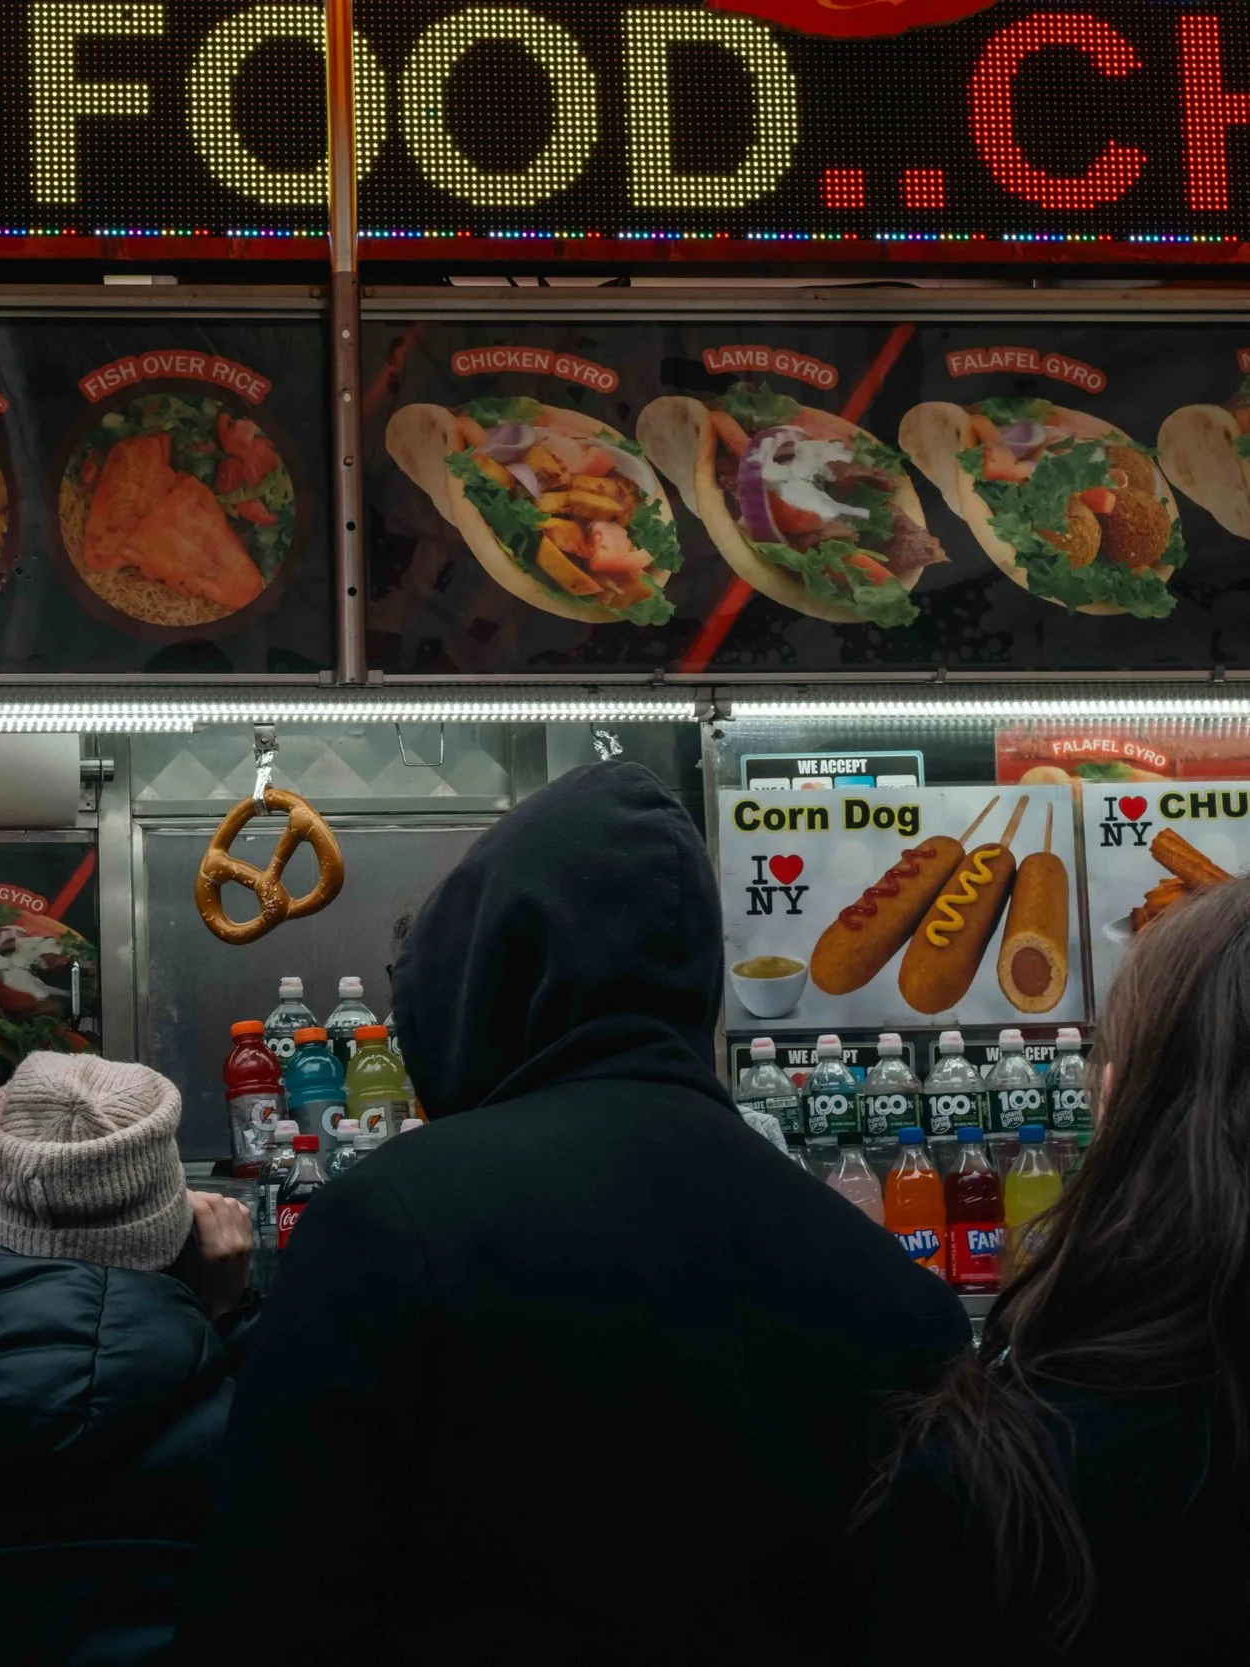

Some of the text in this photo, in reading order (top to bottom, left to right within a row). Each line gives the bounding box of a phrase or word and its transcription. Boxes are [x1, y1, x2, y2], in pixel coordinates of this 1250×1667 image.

[84, 355, 266, 399] FISH OVER RICE
[456, 351, 614, 388] CHICKEN GYRO
[707, 351, 834, 385] LAMB GYRO
[949, 351, 1102, 389] FALAFEL GYRO
[797, 758, 868, 775] WE ACCEPT
[1052, 738, 1167, 768] FALAFEL GYRO
[733, 796, 922, 838] Corn Dog
[1102, 796, 1119, 822] I
[1100, 822, 1154, 847] NY
[751, 855, 770, 885] I
[745, 885, 810, 916] NY
[788, 1049, 859, 1064] WE APT
[984, 1046, 1055, 1062] W CEPT
[360, 1107, 389, 1140] G
